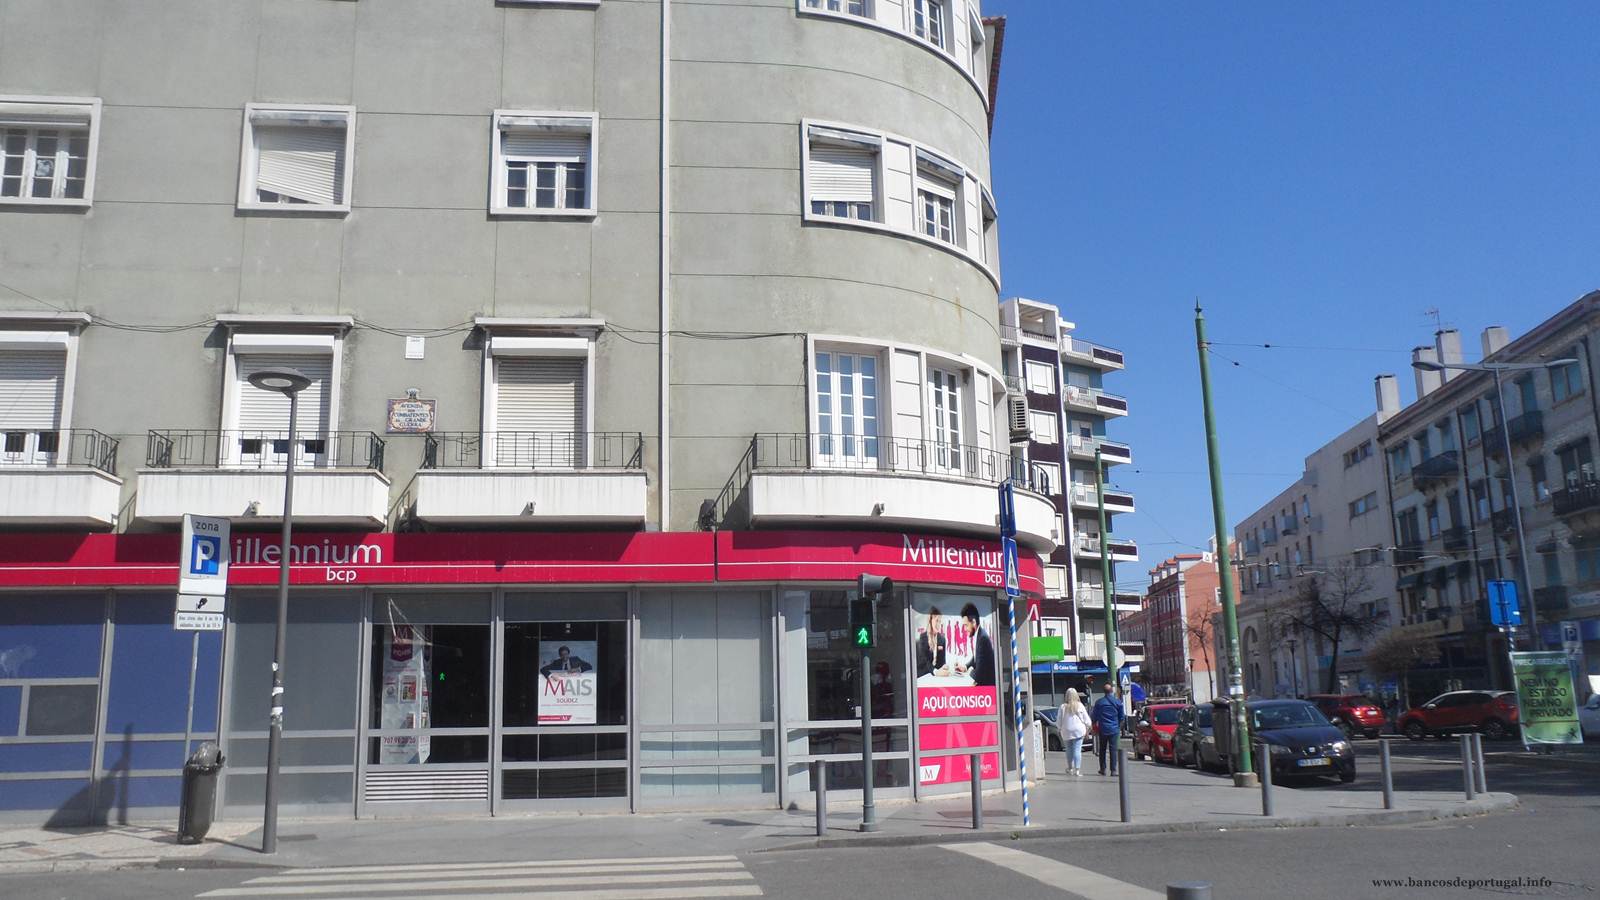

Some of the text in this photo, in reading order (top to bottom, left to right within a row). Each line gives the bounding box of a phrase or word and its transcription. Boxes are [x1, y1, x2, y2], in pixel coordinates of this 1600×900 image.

[195, 521, 219, 532] zona
[196, 540, 215, 570] P
[229, 538, 382, 564] illennium
[326, 567, 357, 583] bcp
[984, 570, 1002, 586] bcp
[544, 678, 593, 696] MAIS
[1529, 687, 1567, 697] ESTADO
[922, 695, 992, 712] AQUI CONSIGO
[1530, 707, 1573, 717] PRIVADO
